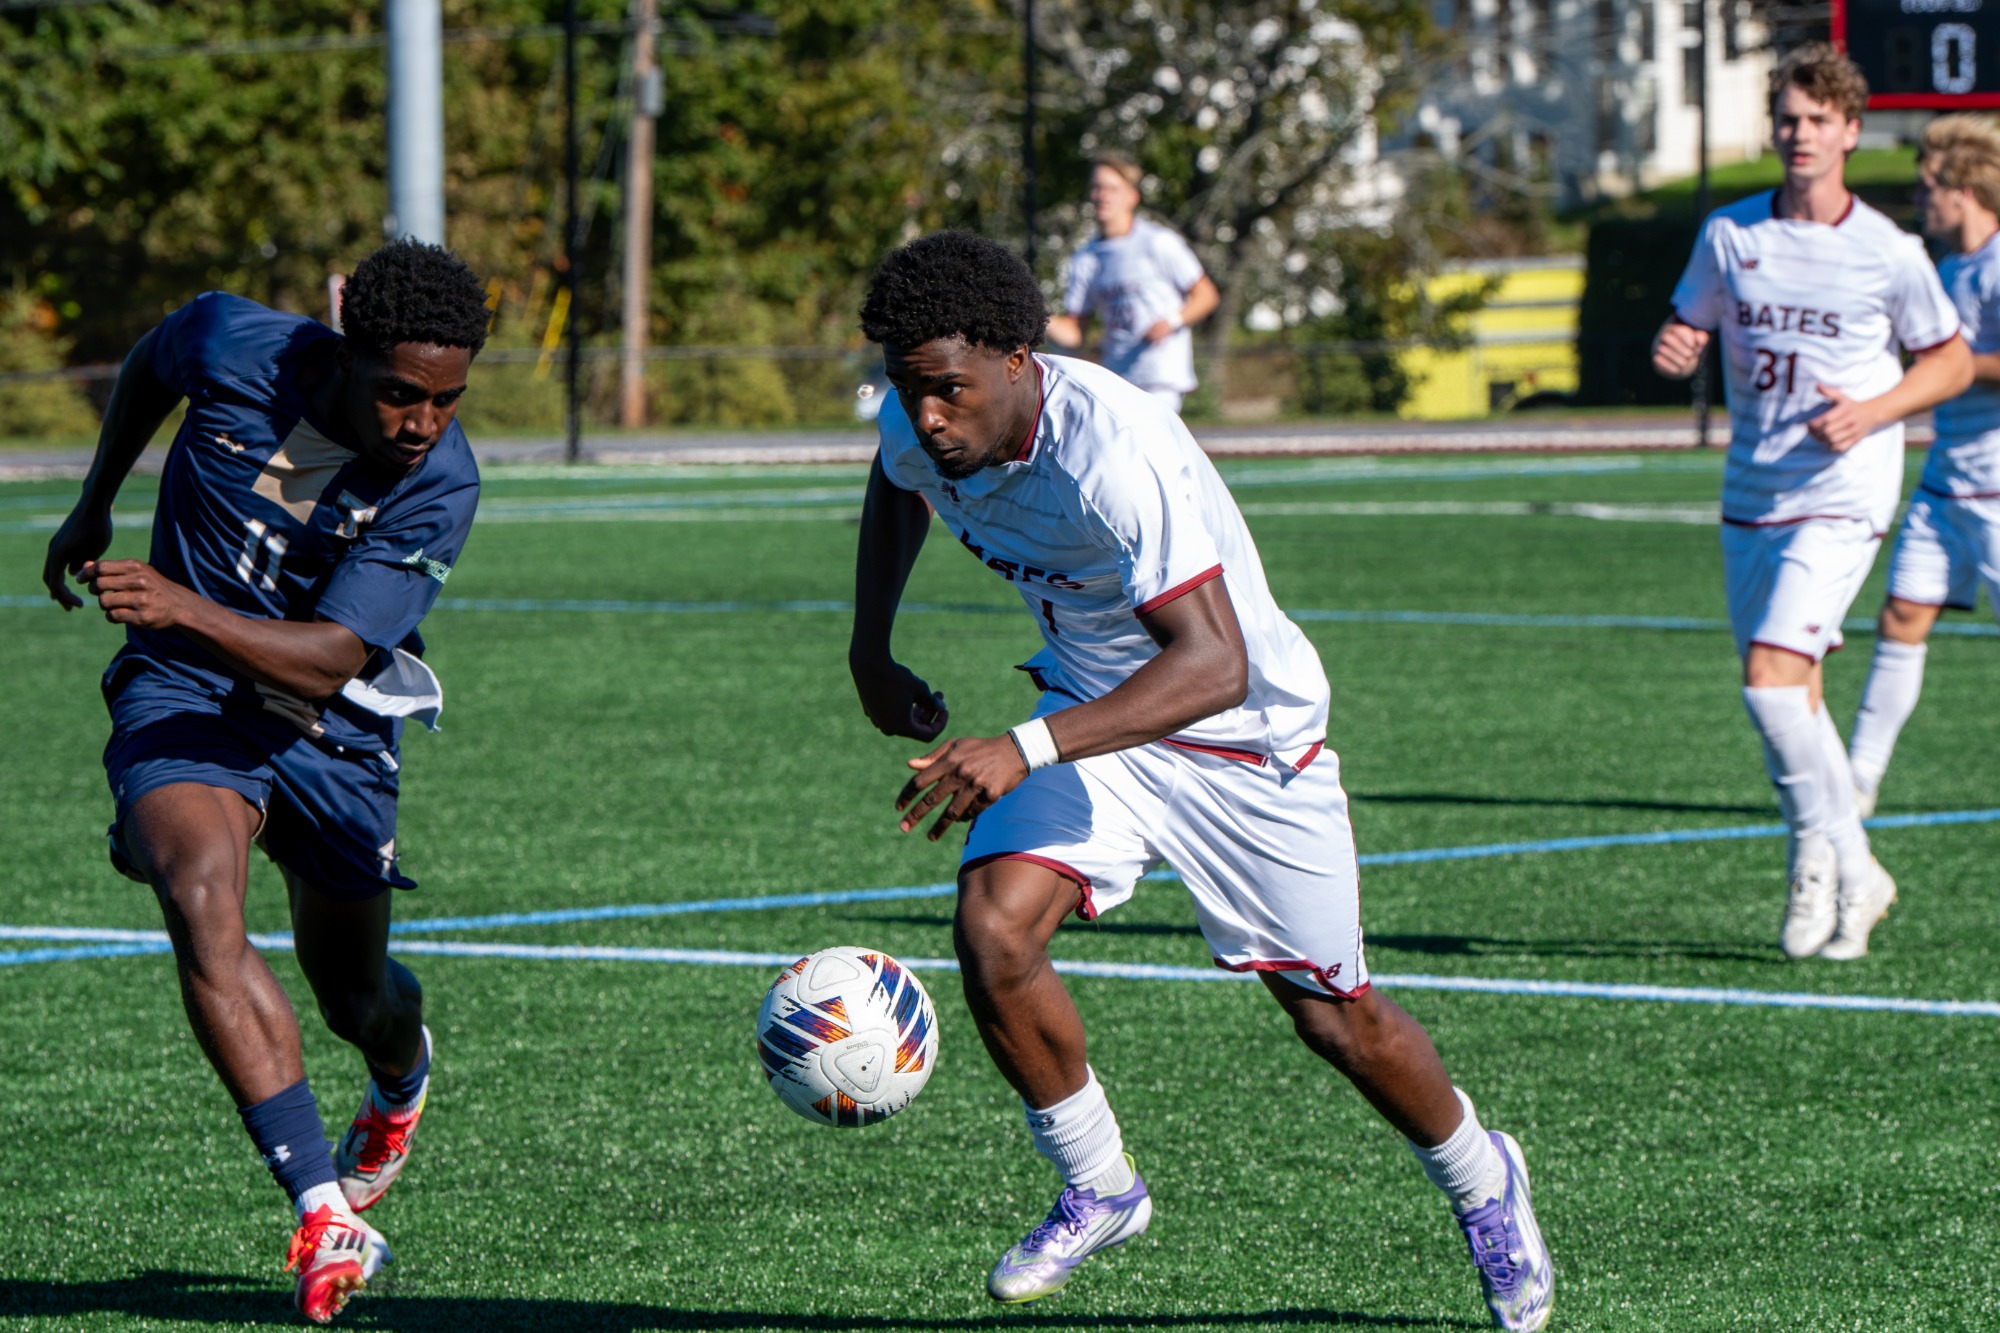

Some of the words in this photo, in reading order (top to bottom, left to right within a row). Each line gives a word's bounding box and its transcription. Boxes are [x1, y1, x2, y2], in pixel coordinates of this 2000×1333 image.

[1932, 23, 1976, 94] 0
[1737, 301, 1841, 338] BATES
[1755, 347, 1798, 394] 31
[236, 518, 289, 593] 11
